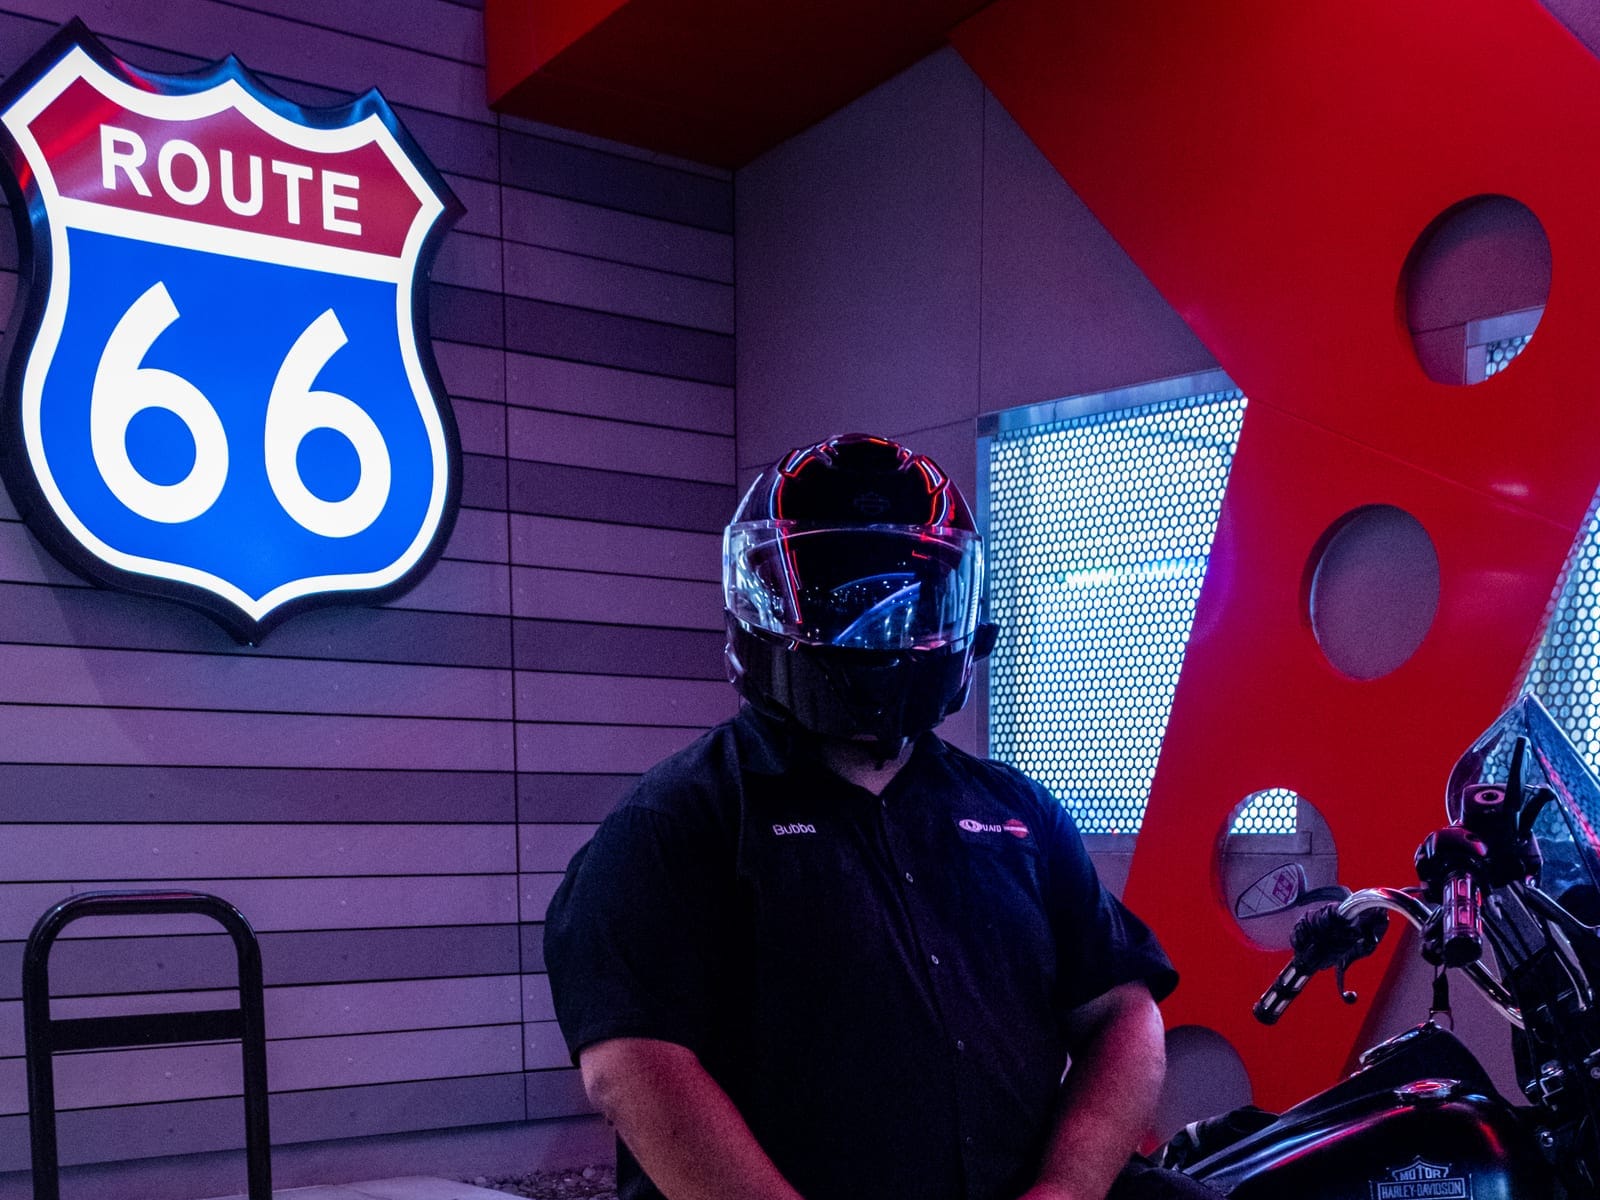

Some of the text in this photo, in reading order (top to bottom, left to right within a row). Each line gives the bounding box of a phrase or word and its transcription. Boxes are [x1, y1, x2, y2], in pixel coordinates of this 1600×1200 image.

[99, 123, 362, 237] ROUTE
[90, 280, 392, 539] 66
[772, 822, 817, 836] Bubba
[1399, 1164, 1442, 1181] MOTOR
[1380, 1181, 1463, 1200] HARLEY-DAVIDSON
